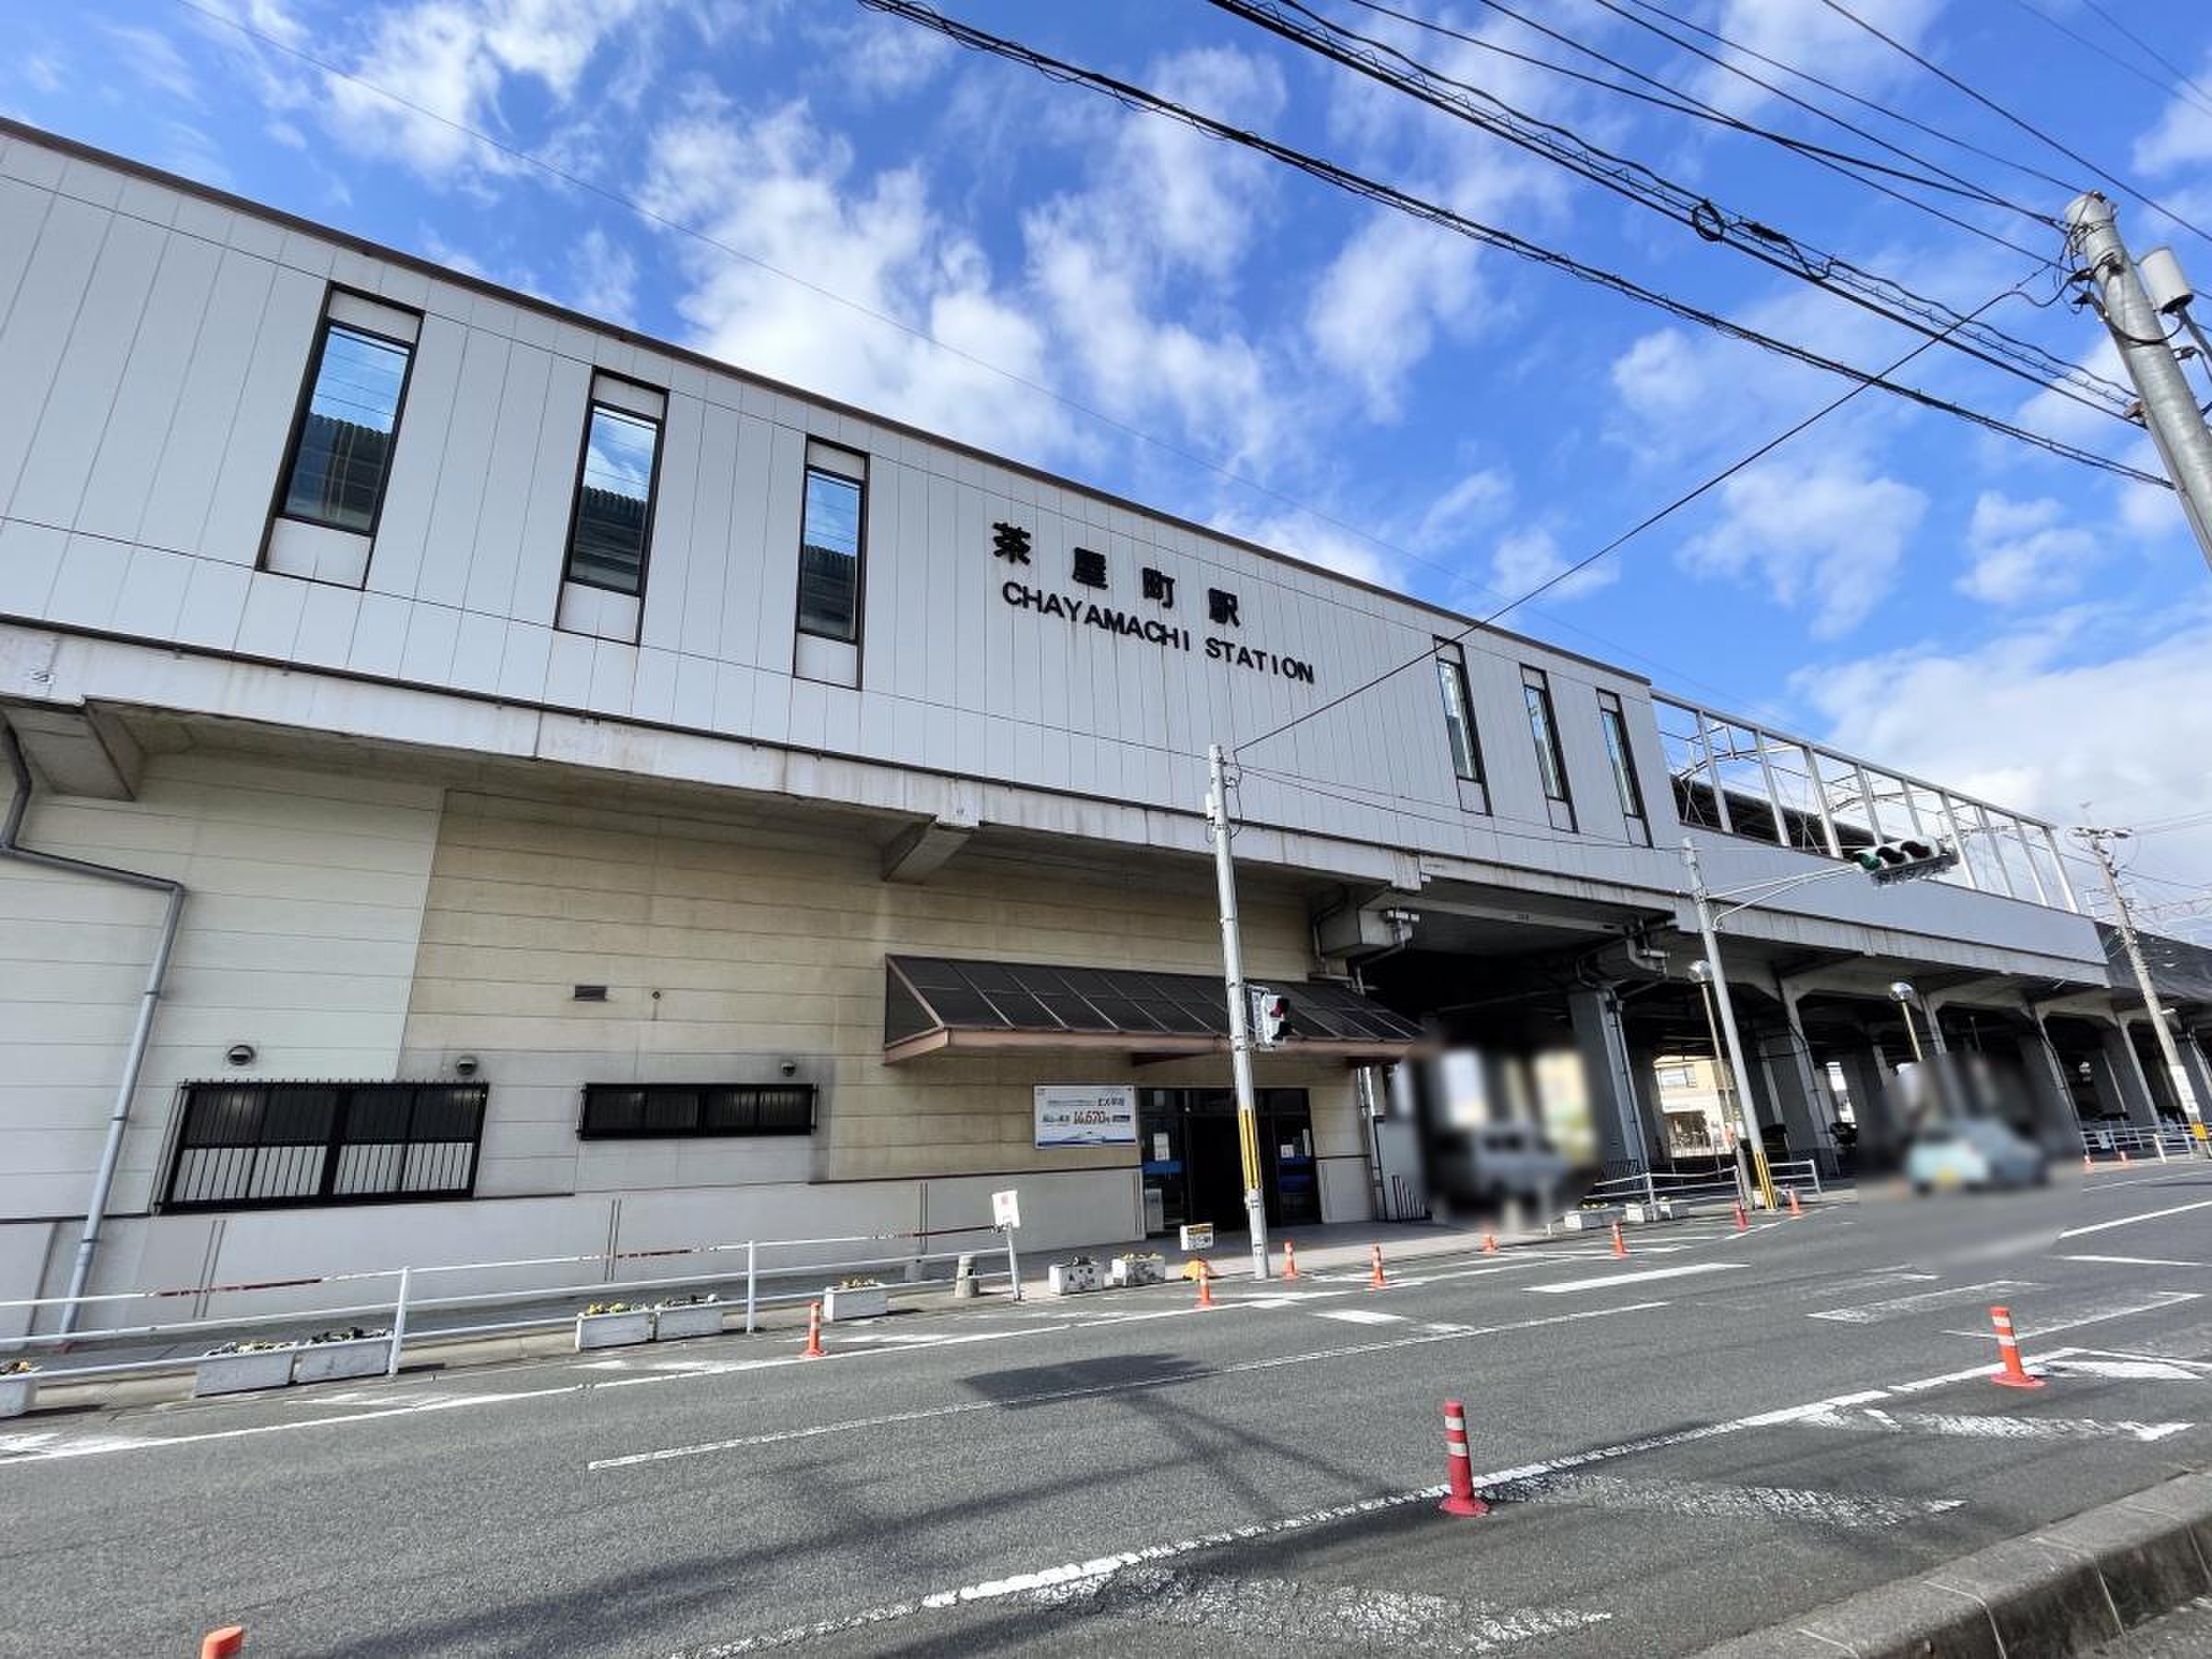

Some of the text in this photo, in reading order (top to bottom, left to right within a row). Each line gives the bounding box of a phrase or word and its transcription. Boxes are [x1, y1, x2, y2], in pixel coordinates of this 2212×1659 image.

[993, 522, 1241, 628] 茶屋町駅
[1002, 581, 1314, 685] CHAYAMACHI STATION
